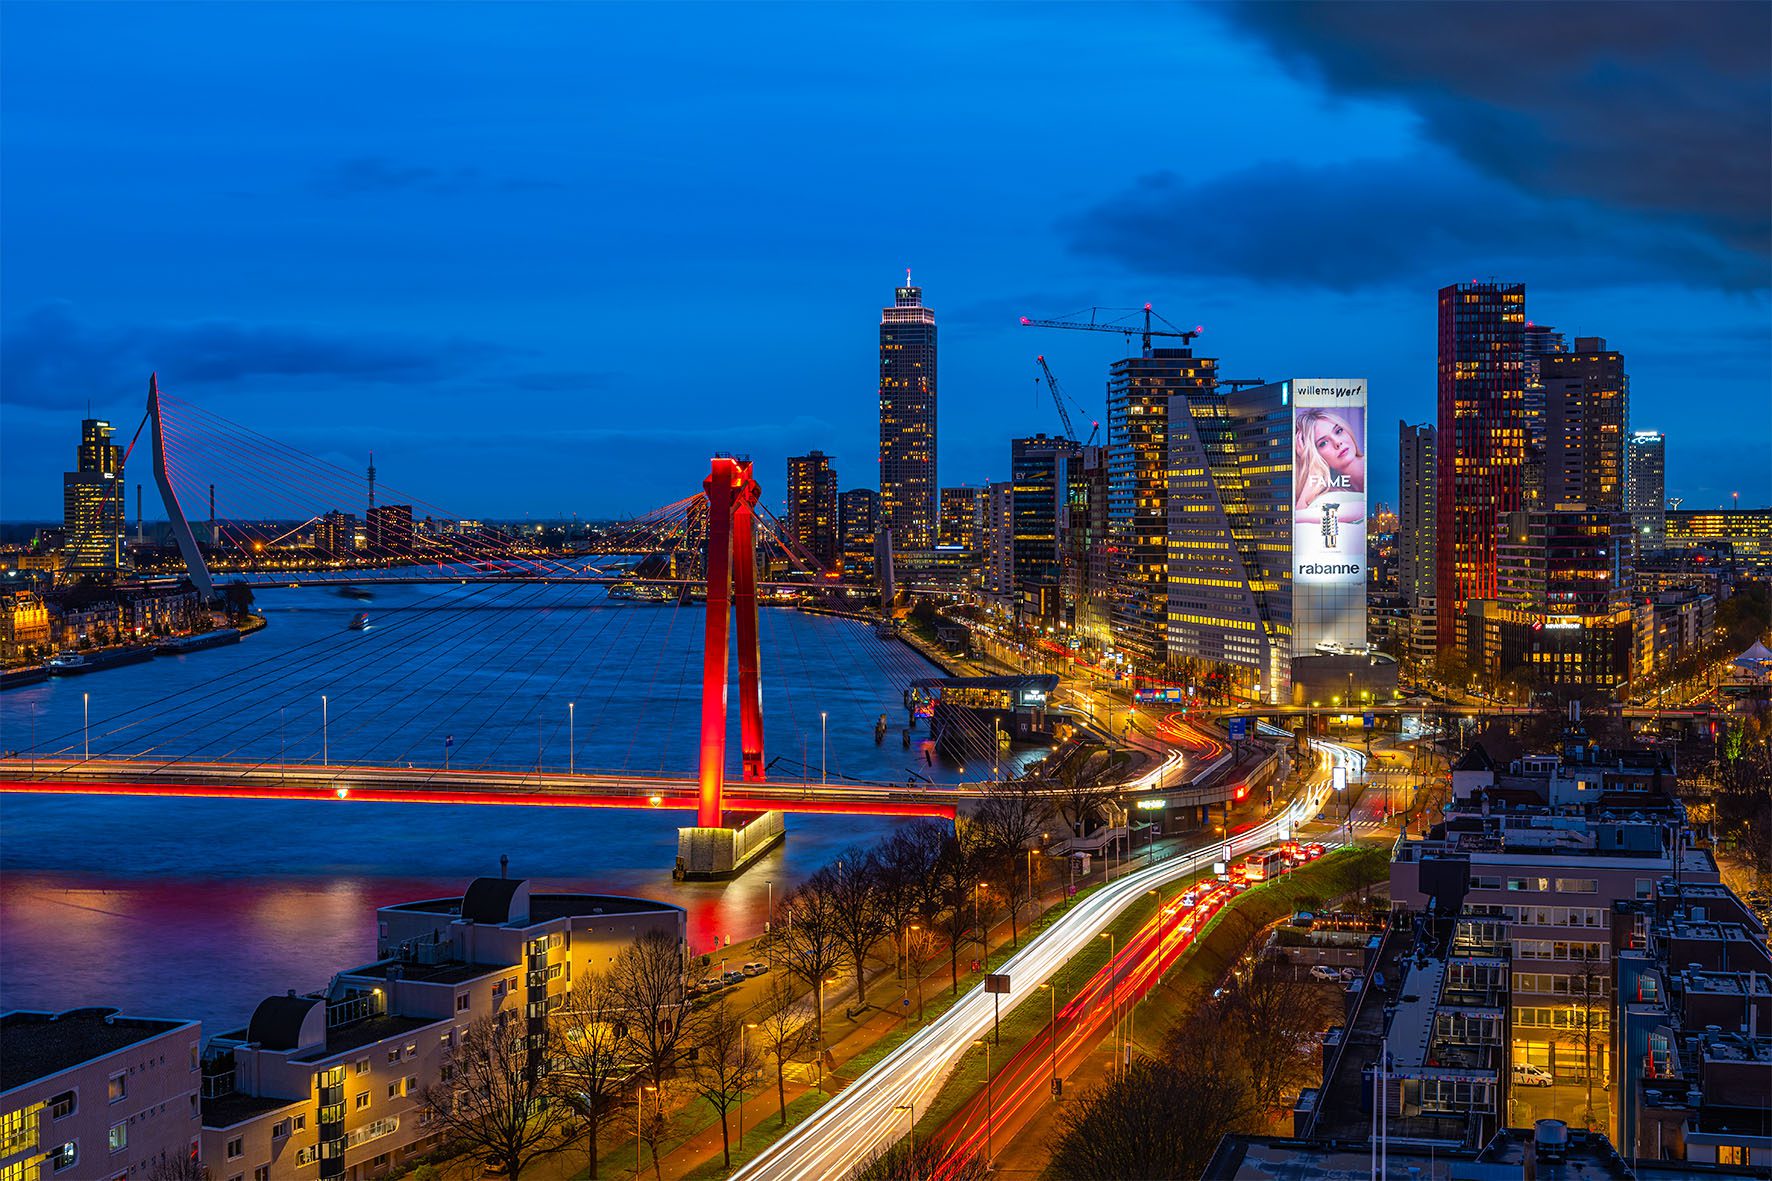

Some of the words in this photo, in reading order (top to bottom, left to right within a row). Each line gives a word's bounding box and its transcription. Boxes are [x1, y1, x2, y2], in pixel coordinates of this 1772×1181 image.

[1015, 472, 1026, 480] EY
[1309, 474, 1351, 488] FAME
[1299, 563, 1360, 575] rabanne
